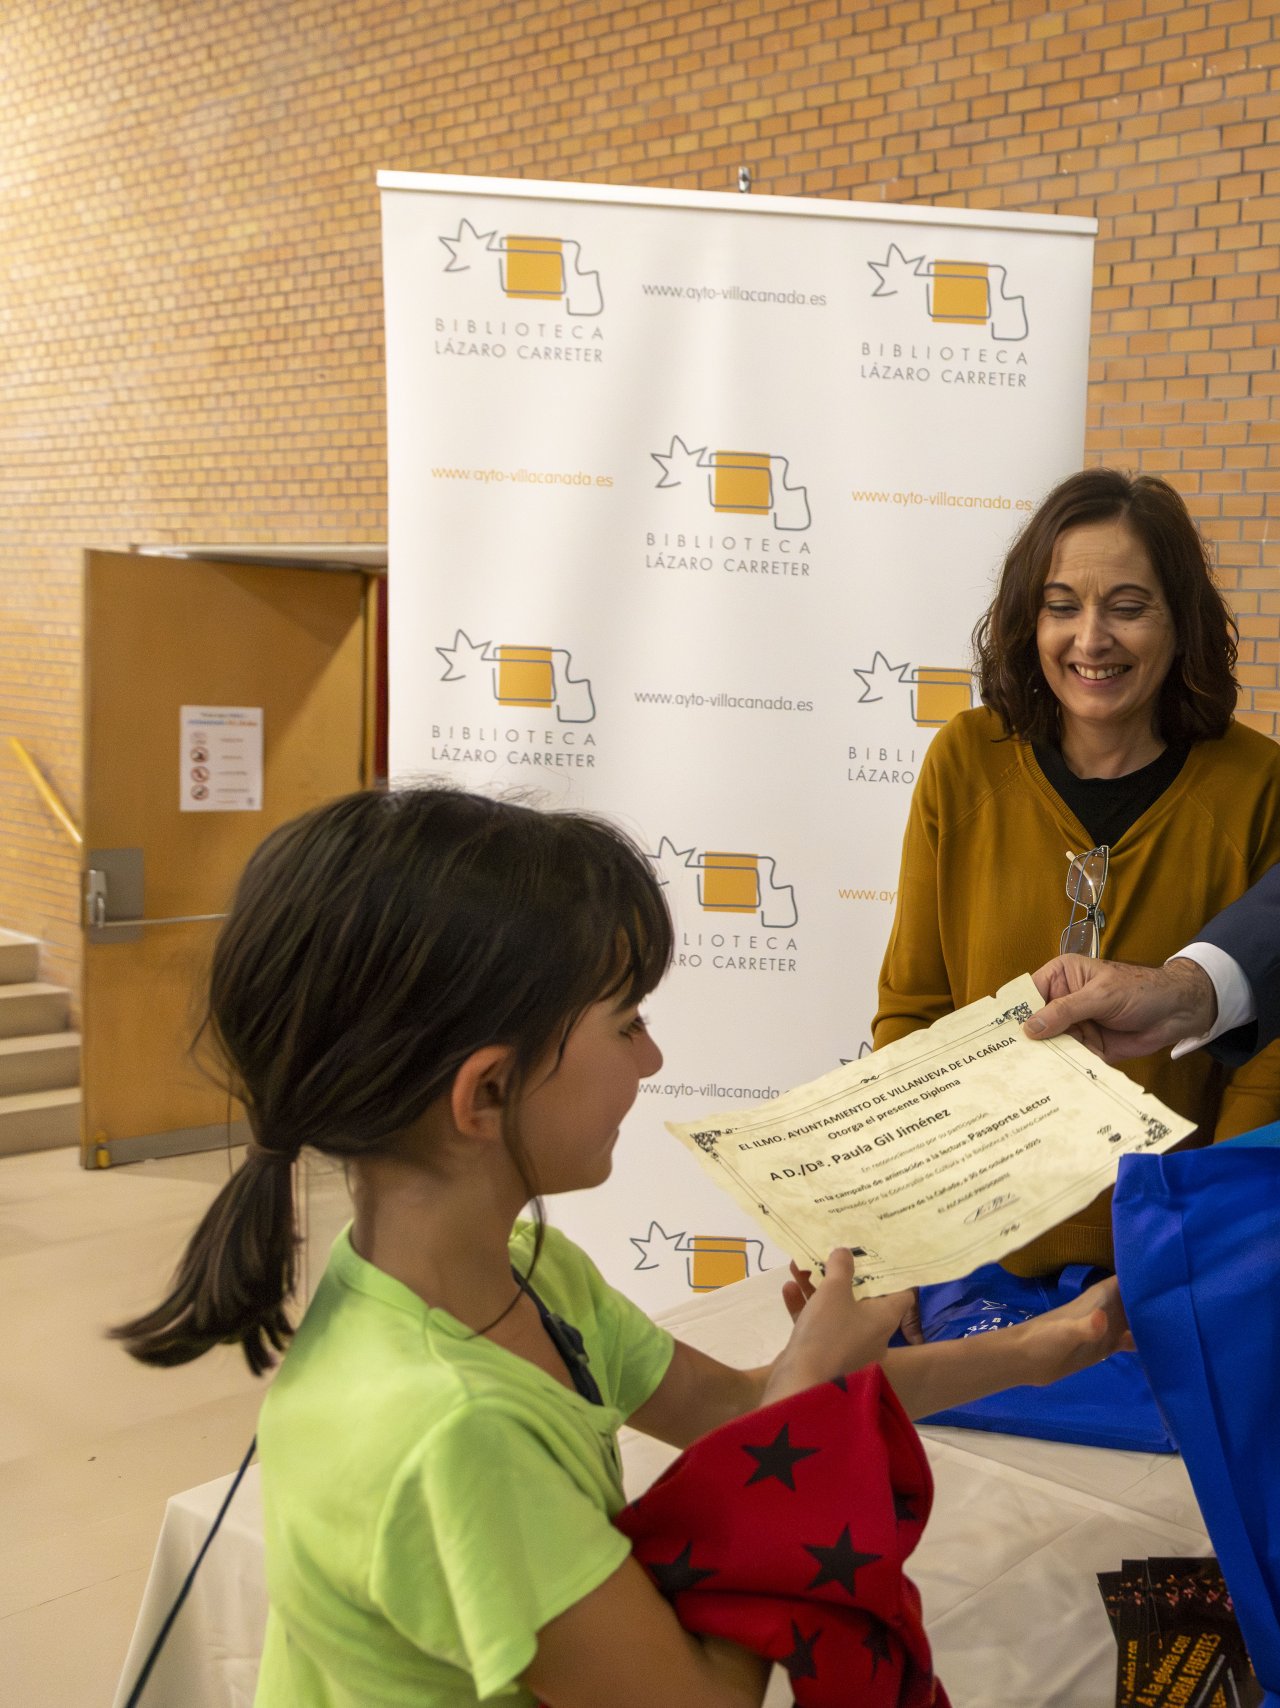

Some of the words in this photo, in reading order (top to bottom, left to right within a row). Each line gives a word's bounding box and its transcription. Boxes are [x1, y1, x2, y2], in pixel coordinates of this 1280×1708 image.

[642, 284, 828, 306] www.ayto-villacanada.es
[435, 317, 604, 340] BIBLIOTECA
[435, 338, 506, 359] LÁZARO
[517, 345, 603, 363] CARRETER
[861, 342, 1028, 365] BIBLIOTECA
[861, 362, 930, 382] LÁZARO
[941, 369, 1027, 388] CARRETER
[431, 467, 614, 488] www.ayto-villacanada.es
[851, 489, 1033, 512] www.ayto-villacanada.es
[646, 532, 811, 554] BIBLIOTECA
[646, 552, 713, 571] LÁZARO
[723, 558, 810, 576] CARRETER
[634, 692, 814, 713] www.ayto-villacanada.es
[432, 725, 596, 746] BIBLIOTECA
[432, 744, 497, 763] LÁZARO
[507, 750, 595, 768] CARRETER
[848, 746, 915, 763] BIBLI
[847, 765, 915, 784] LÁZARO
[683, 932, 798, 951] LIOTECA
[712, 955, 797, 972] CARRETER
[638, 1083, 790, 1099] ww.ayto-villacanada
[738, 1143, 753, 1151] EL
[752, 1135, 786, 1148] ILMO.
[787, 1101, 872, 1139] AYUNTAMIENTO
[872, 1093, 887, 1105] DE
[887, 1067, 949, 1097] VILLANUEVA
[948, 1060, 963, 1071] DE
[962, 1055, 977, 1064] LA
[976, 1037, 1017, 1058] CAÑADA
[827, 1122, 864, 1140] Otorga
[865, 1116, 876, 1125] el
[876, 1098, 920, 1121] presente
[919, 1080, 961, 1100] Diploma
[967, 1113, 1020, 1141] Pasaporte
[1019, 1096, 1051, 1115] Lector
[770, 1172, 783, 1181] A
[831, 1144, 873, 1164] Paula
[874, 1132, 895, 1146] Gil
[896, 1109, 951, 1138] Jiménez
[1161, 1676, 1200, 1708] LORIA
